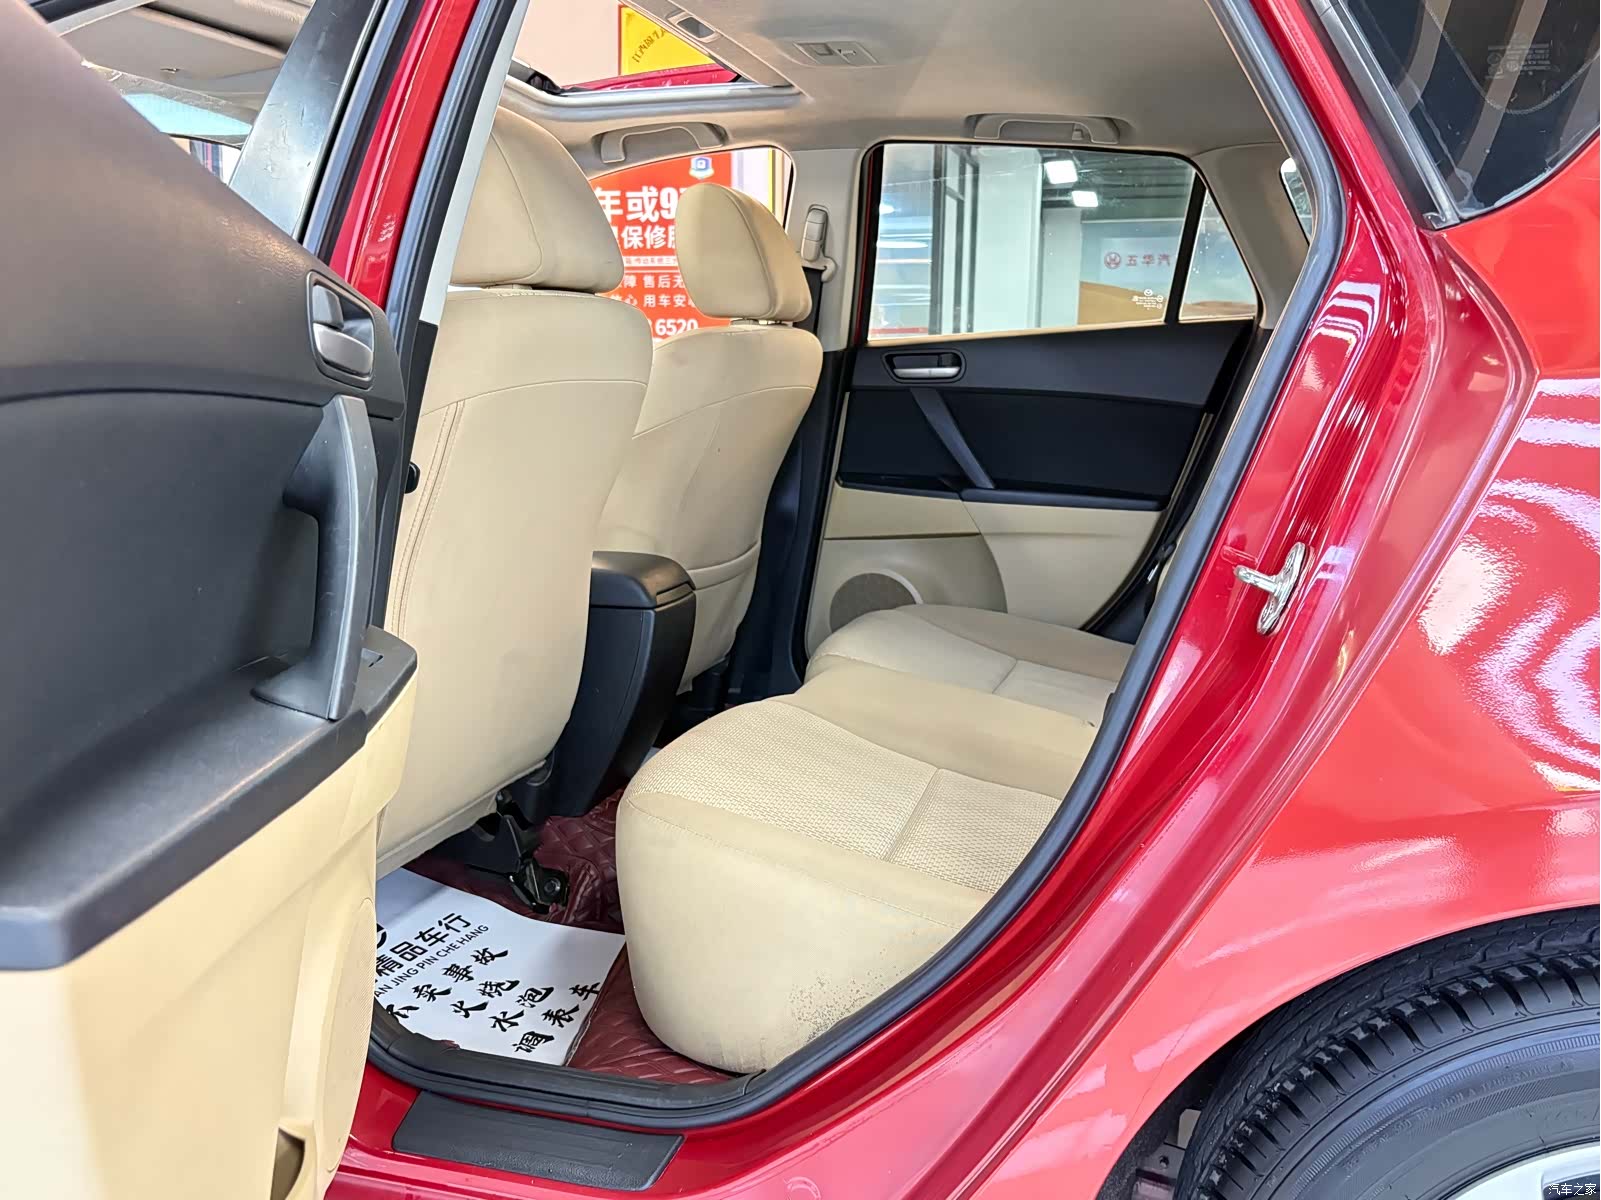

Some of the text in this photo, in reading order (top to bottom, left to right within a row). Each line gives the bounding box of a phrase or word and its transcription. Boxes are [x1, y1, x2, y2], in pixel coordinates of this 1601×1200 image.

[595, 186, 687, 222] 年或9
[620, 275, 637, 289] 障
[656, 319, 699, 336] 6520
[376, 912, 472, 977] 精品车行
[391, 967, 419, 987] JING
[416, 955, 439, 970] PIN
[436, 942, 460, 958] CHE
[459, 924, 489, 946] HANG
[450, 980, 520, 1019] 火烧
[488, 986, 555, 1033] 水泡
